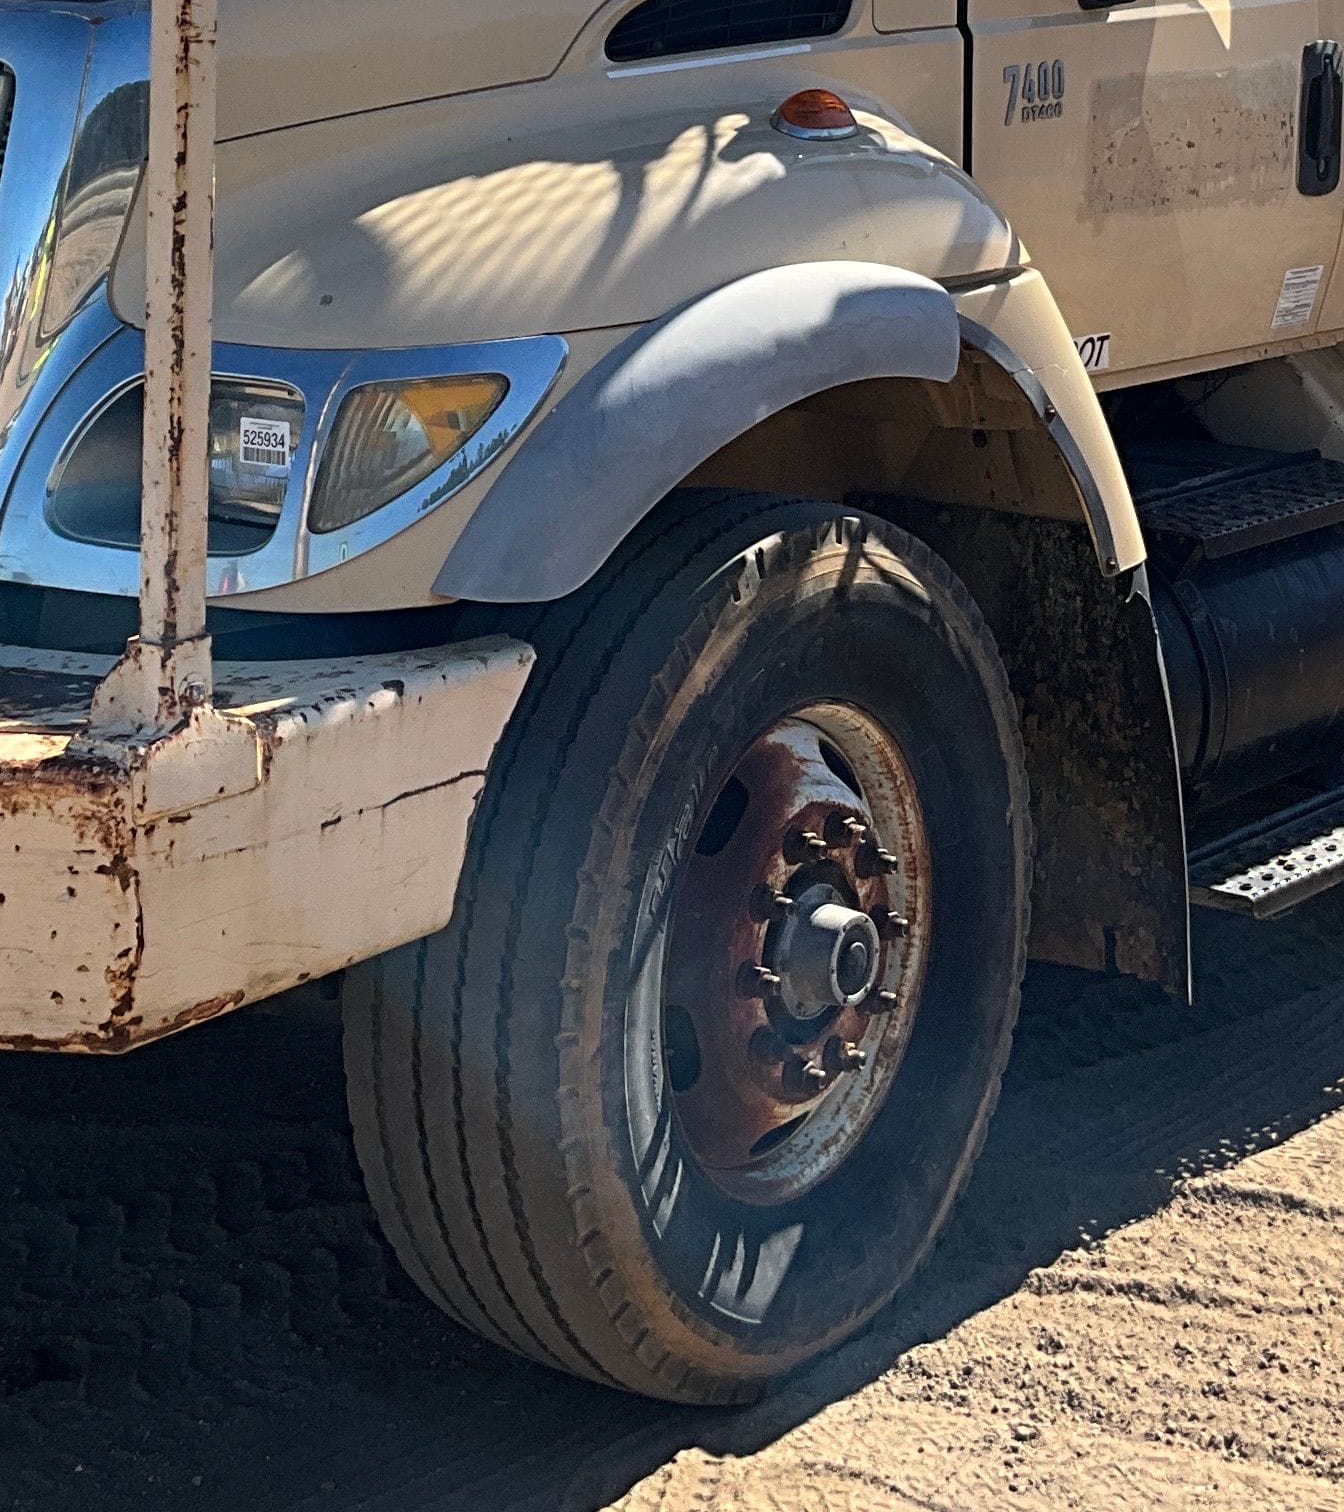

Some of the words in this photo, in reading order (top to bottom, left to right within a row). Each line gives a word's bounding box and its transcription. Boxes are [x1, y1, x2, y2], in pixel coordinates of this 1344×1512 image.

[1002, 58, 1065, 127] 7400
[1073, 334, 1111, 368] OT
[242, 429, 286, 449] 525934
